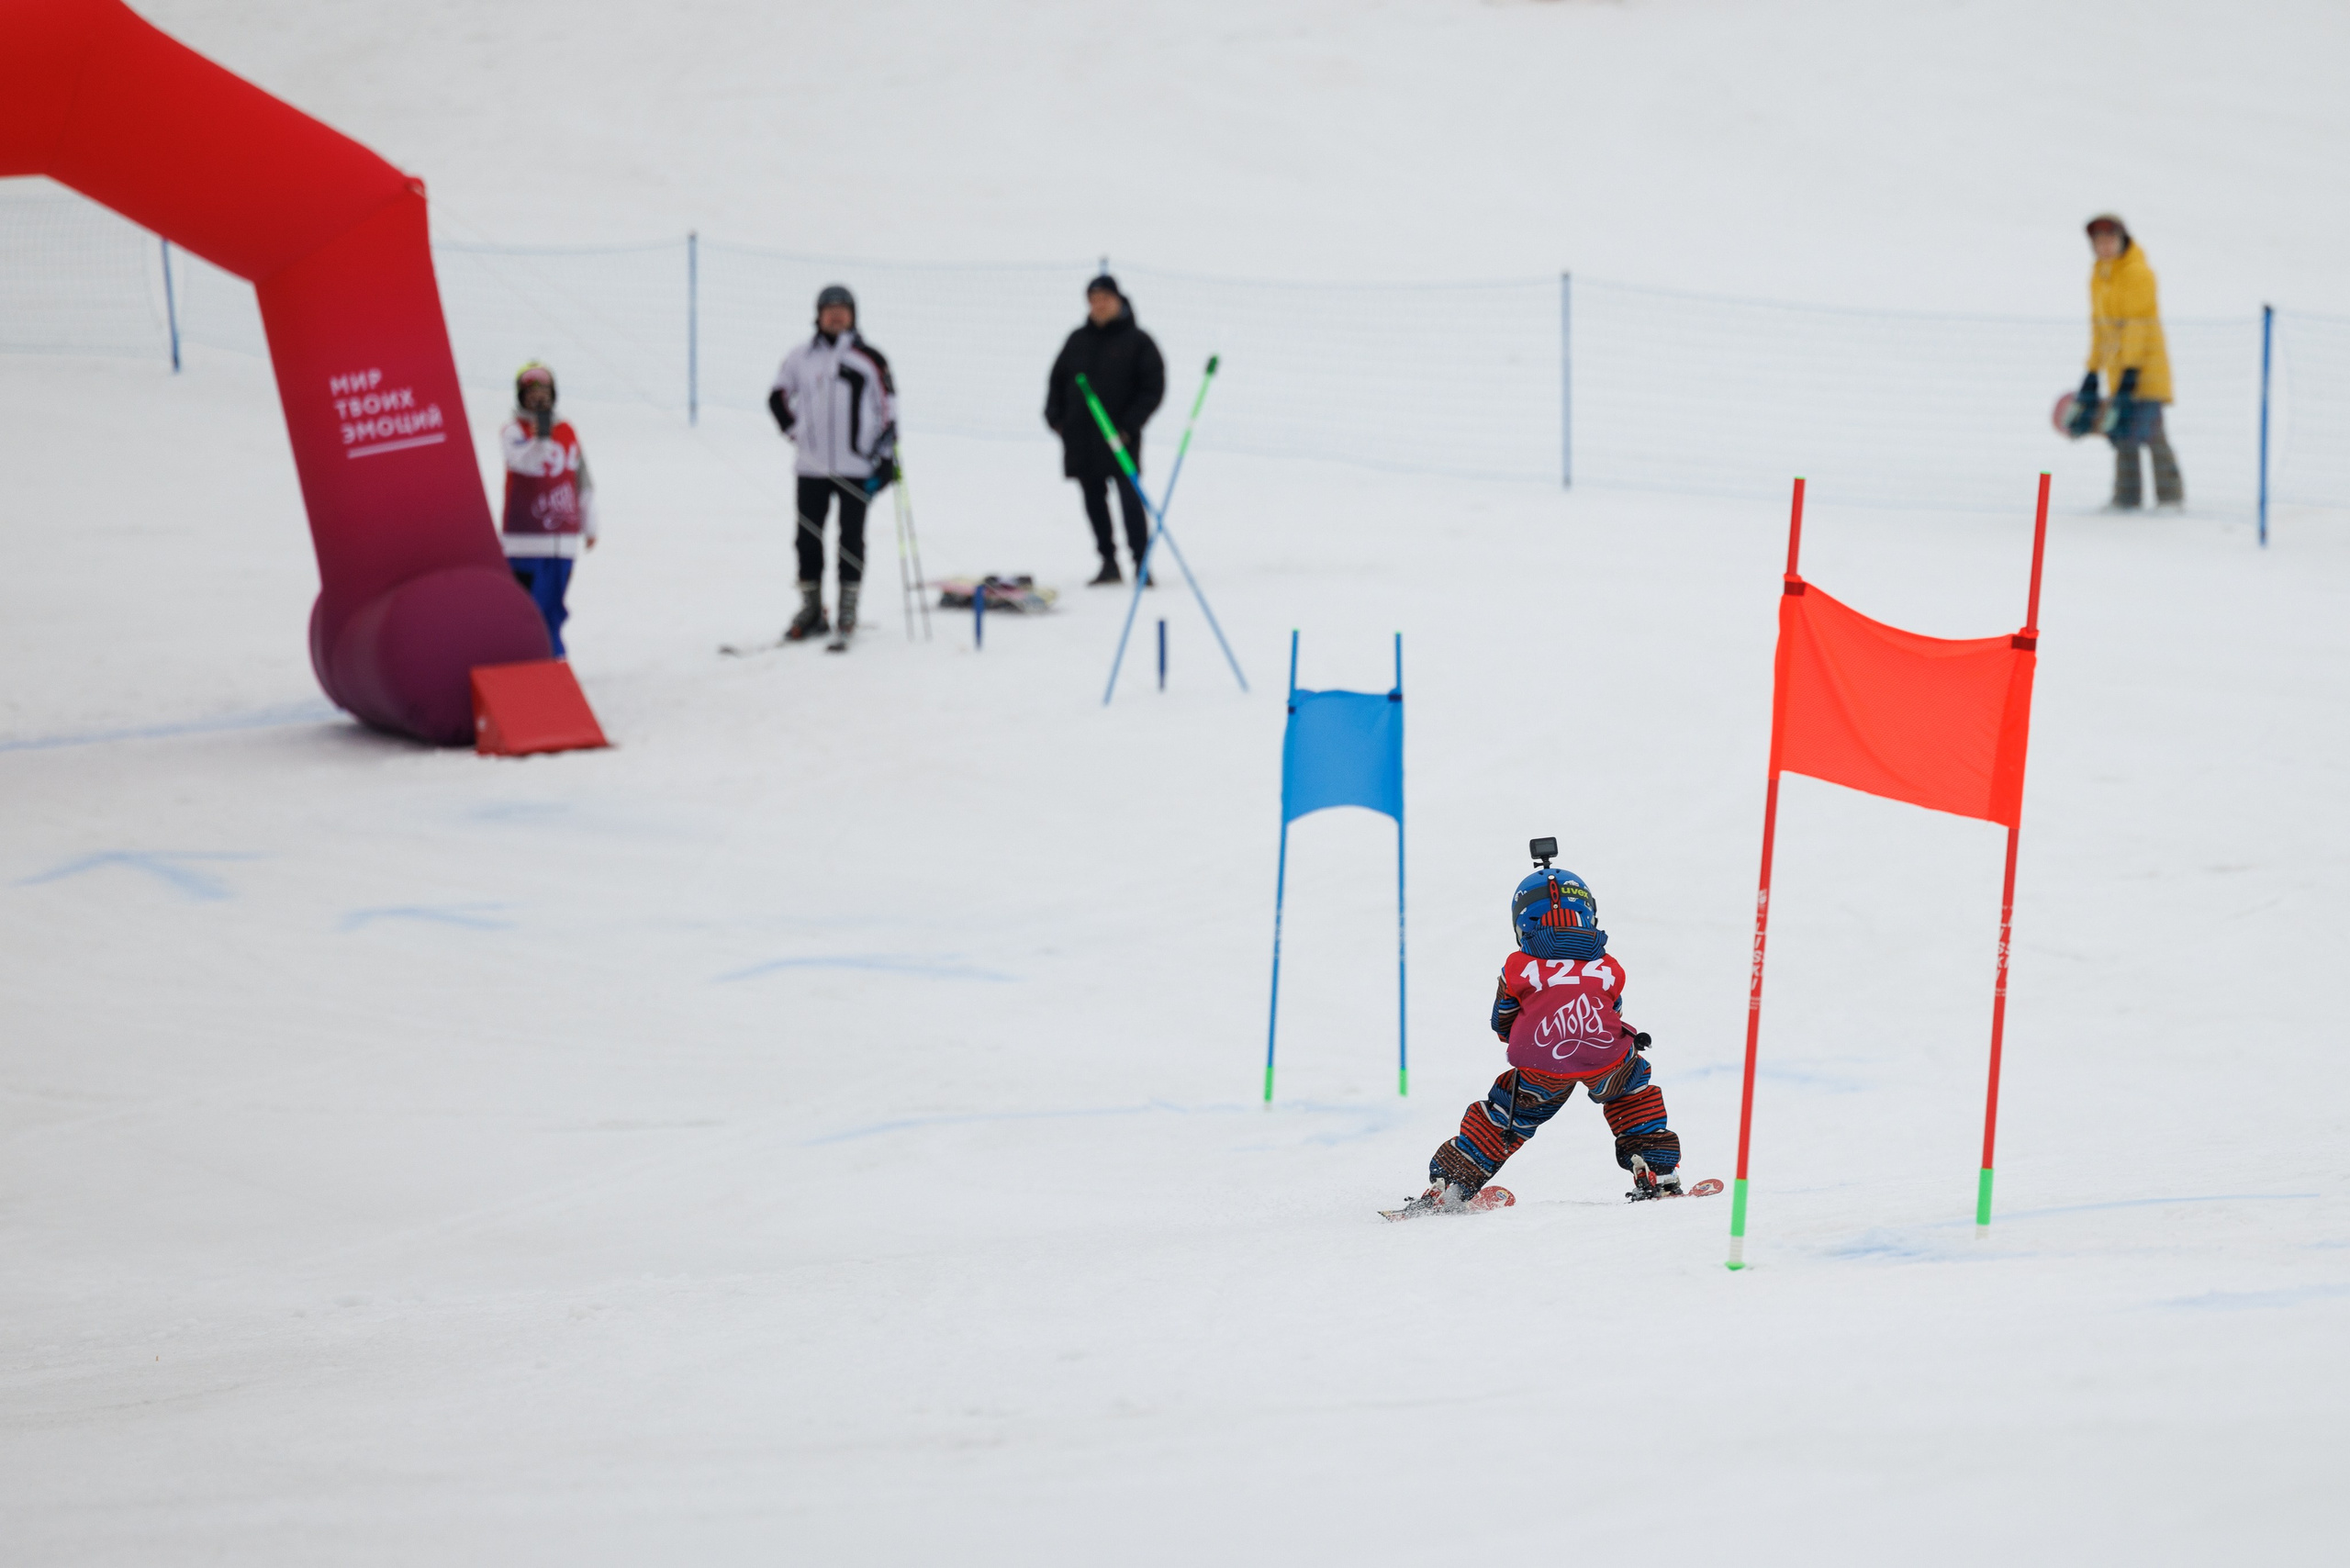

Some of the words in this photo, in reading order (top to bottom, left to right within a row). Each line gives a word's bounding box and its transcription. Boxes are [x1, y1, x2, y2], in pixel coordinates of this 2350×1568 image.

[330, 368, 382, 396] МИР
[335, 387, 413, 419] ТВОИХ
[341, 403, 443, 443] ЭМОЦИЙ
[1561, 887, 1588, 899] uvex
[1520, 958, 1616, 992] 124
